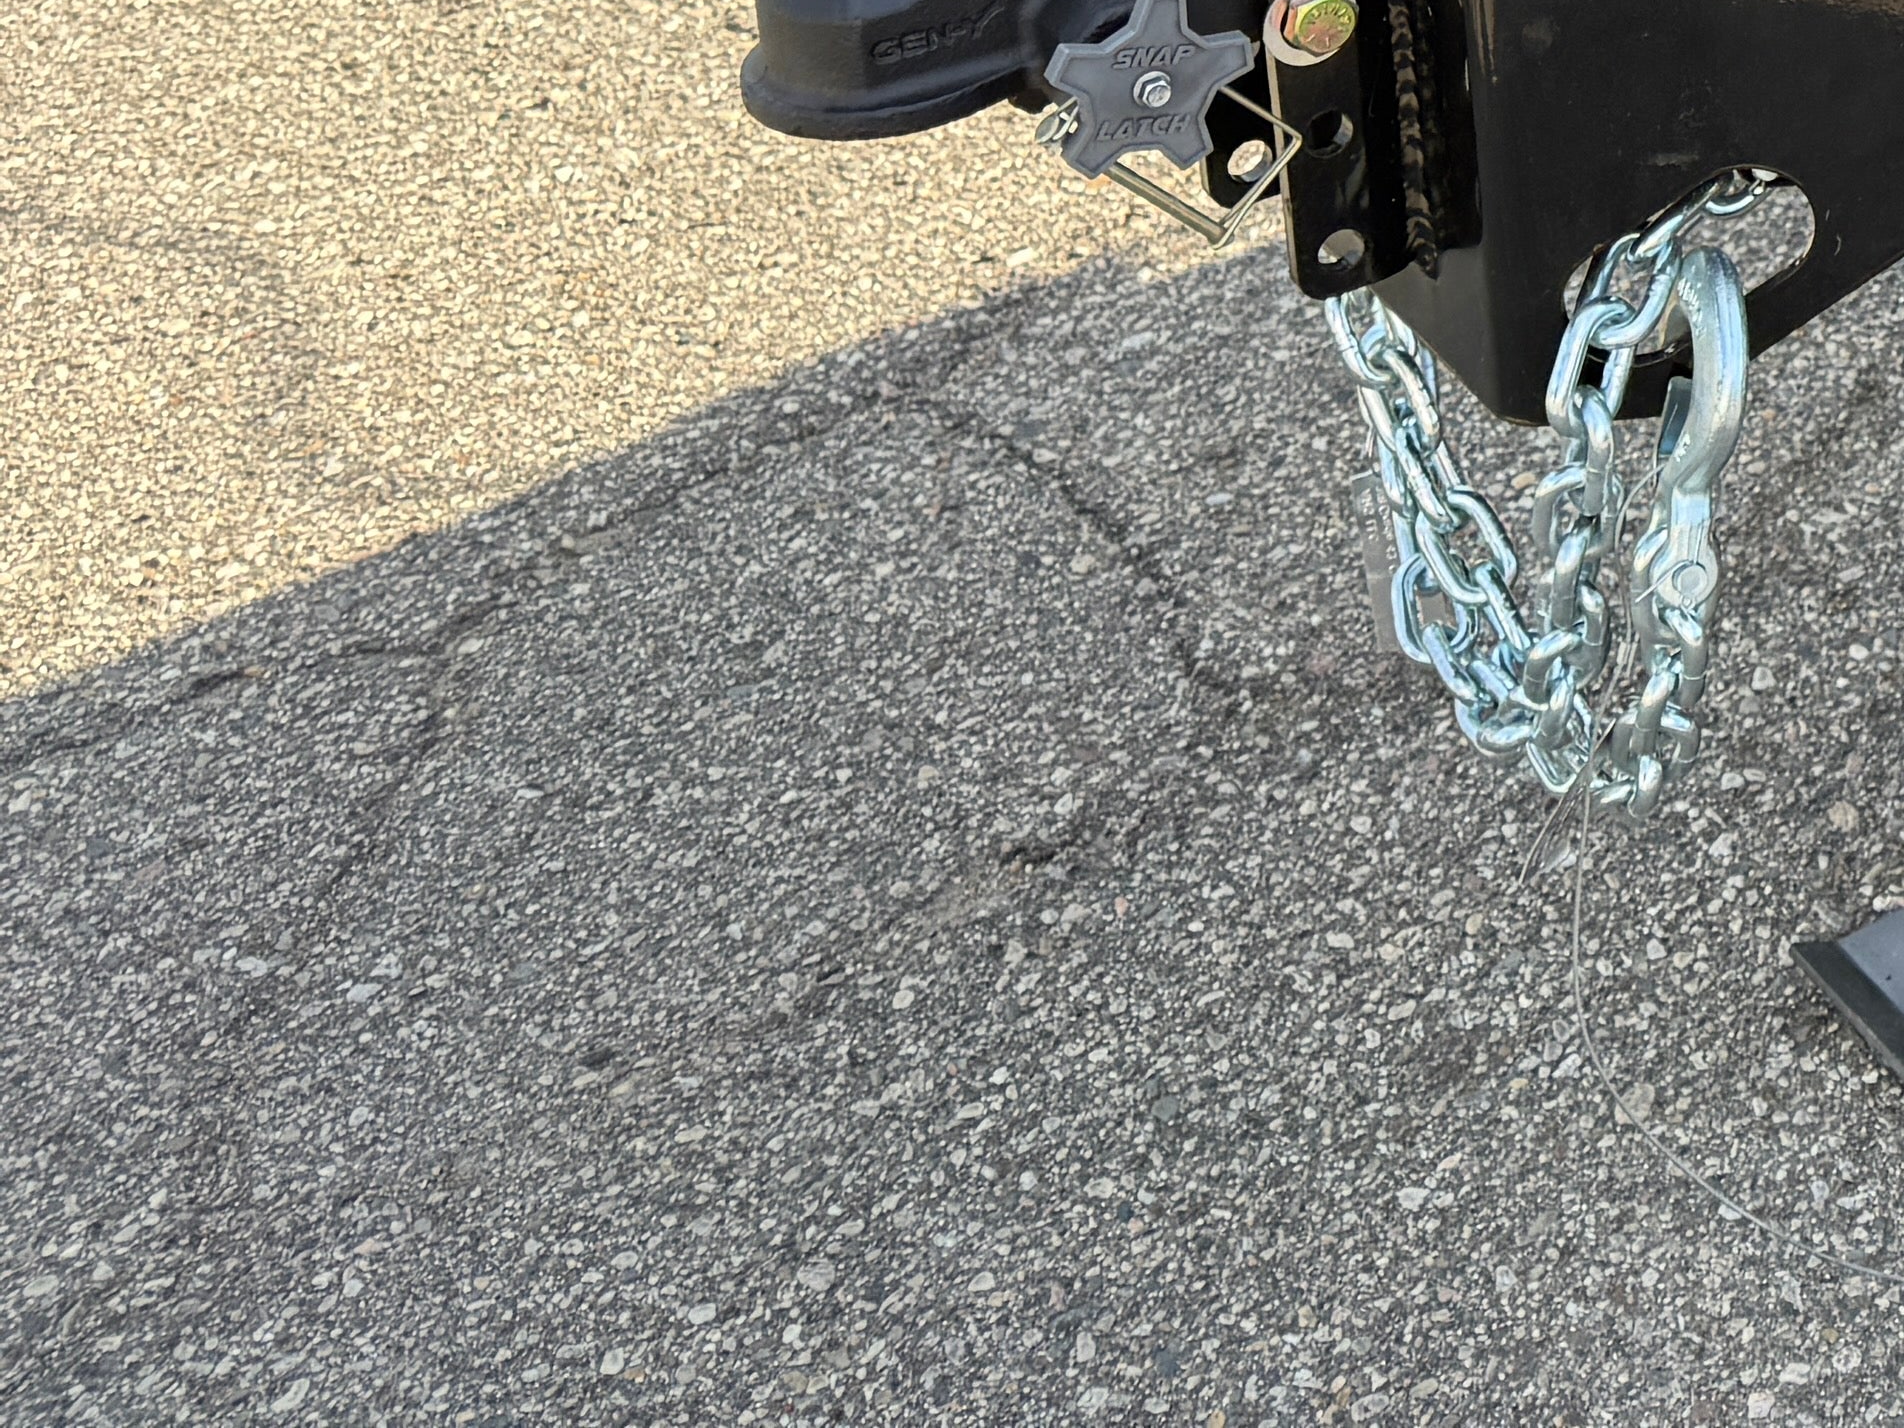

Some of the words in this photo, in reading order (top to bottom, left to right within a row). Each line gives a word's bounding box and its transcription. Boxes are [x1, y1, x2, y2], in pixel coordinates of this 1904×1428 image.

[870, 3, 1004, 65] GEN-Y
[1112, 45, 1196, 70] SNAP
[1096, 114, 1192, 142] LATCH
